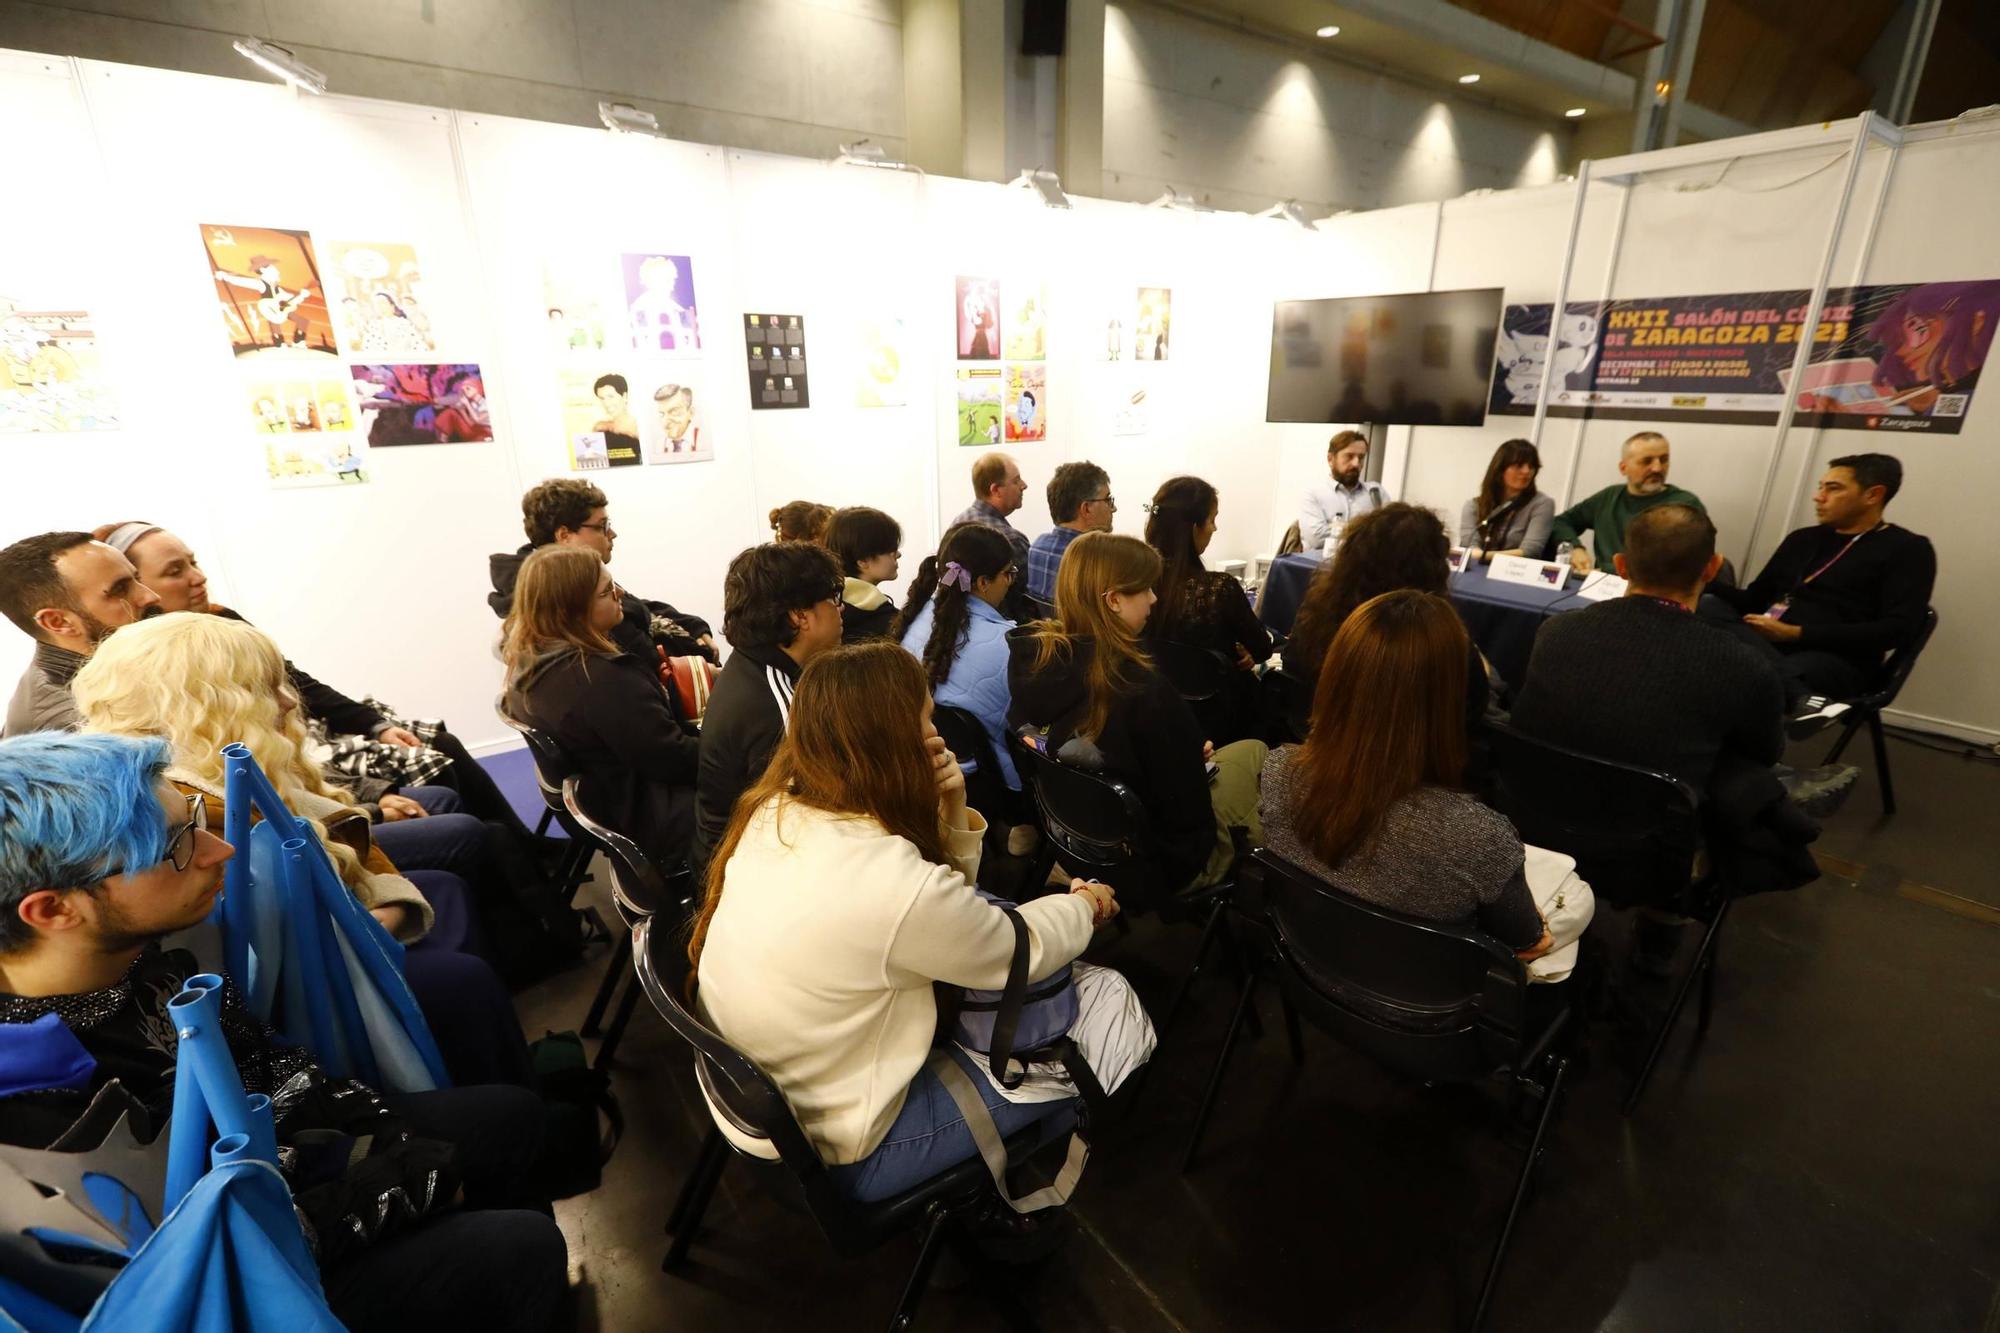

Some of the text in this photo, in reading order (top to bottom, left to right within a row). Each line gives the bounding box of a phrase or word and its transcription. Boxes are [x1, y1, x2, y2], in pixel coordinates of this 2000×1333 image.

[1608, 310, 1668, 328] XXII
[1673, 308, 1737, 326] SALÓN
[1741, 310, 1782, 324] DEL
[1604, 334, 1626, 346] DE
[1632, 325, 1769, 345] ZARAGOZA
[1879, 417, 1931, 429] Zaragoza
